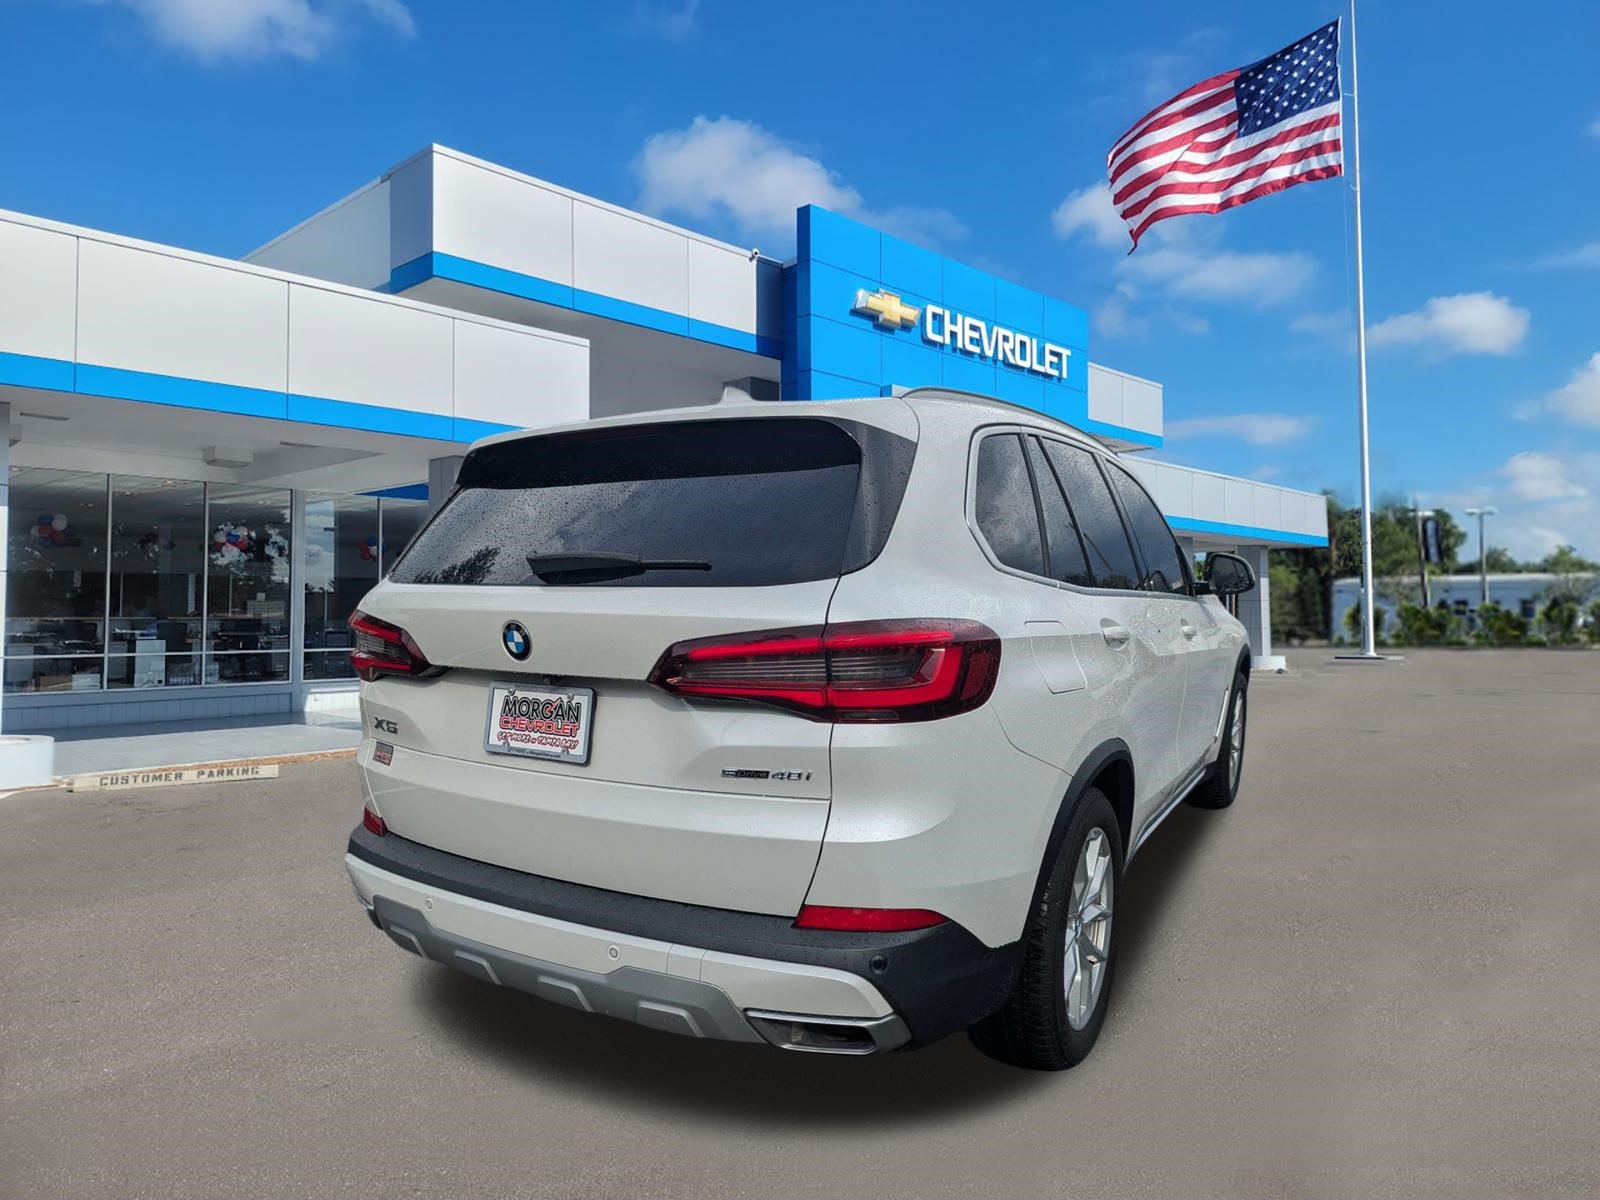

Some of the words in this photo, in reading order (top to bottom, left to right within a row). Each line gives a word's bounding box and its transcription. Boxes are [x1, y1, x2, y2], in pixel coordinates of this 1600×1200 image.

[922, 303, 1072, 380] CHEVROLET
[501, 694, 582, 723] MORGAN
[499, 715, 580, 737] CHEVROLET
[100, 771, 183, 786] CUSTOMER
[197, 766, 259, 779] PARKING
